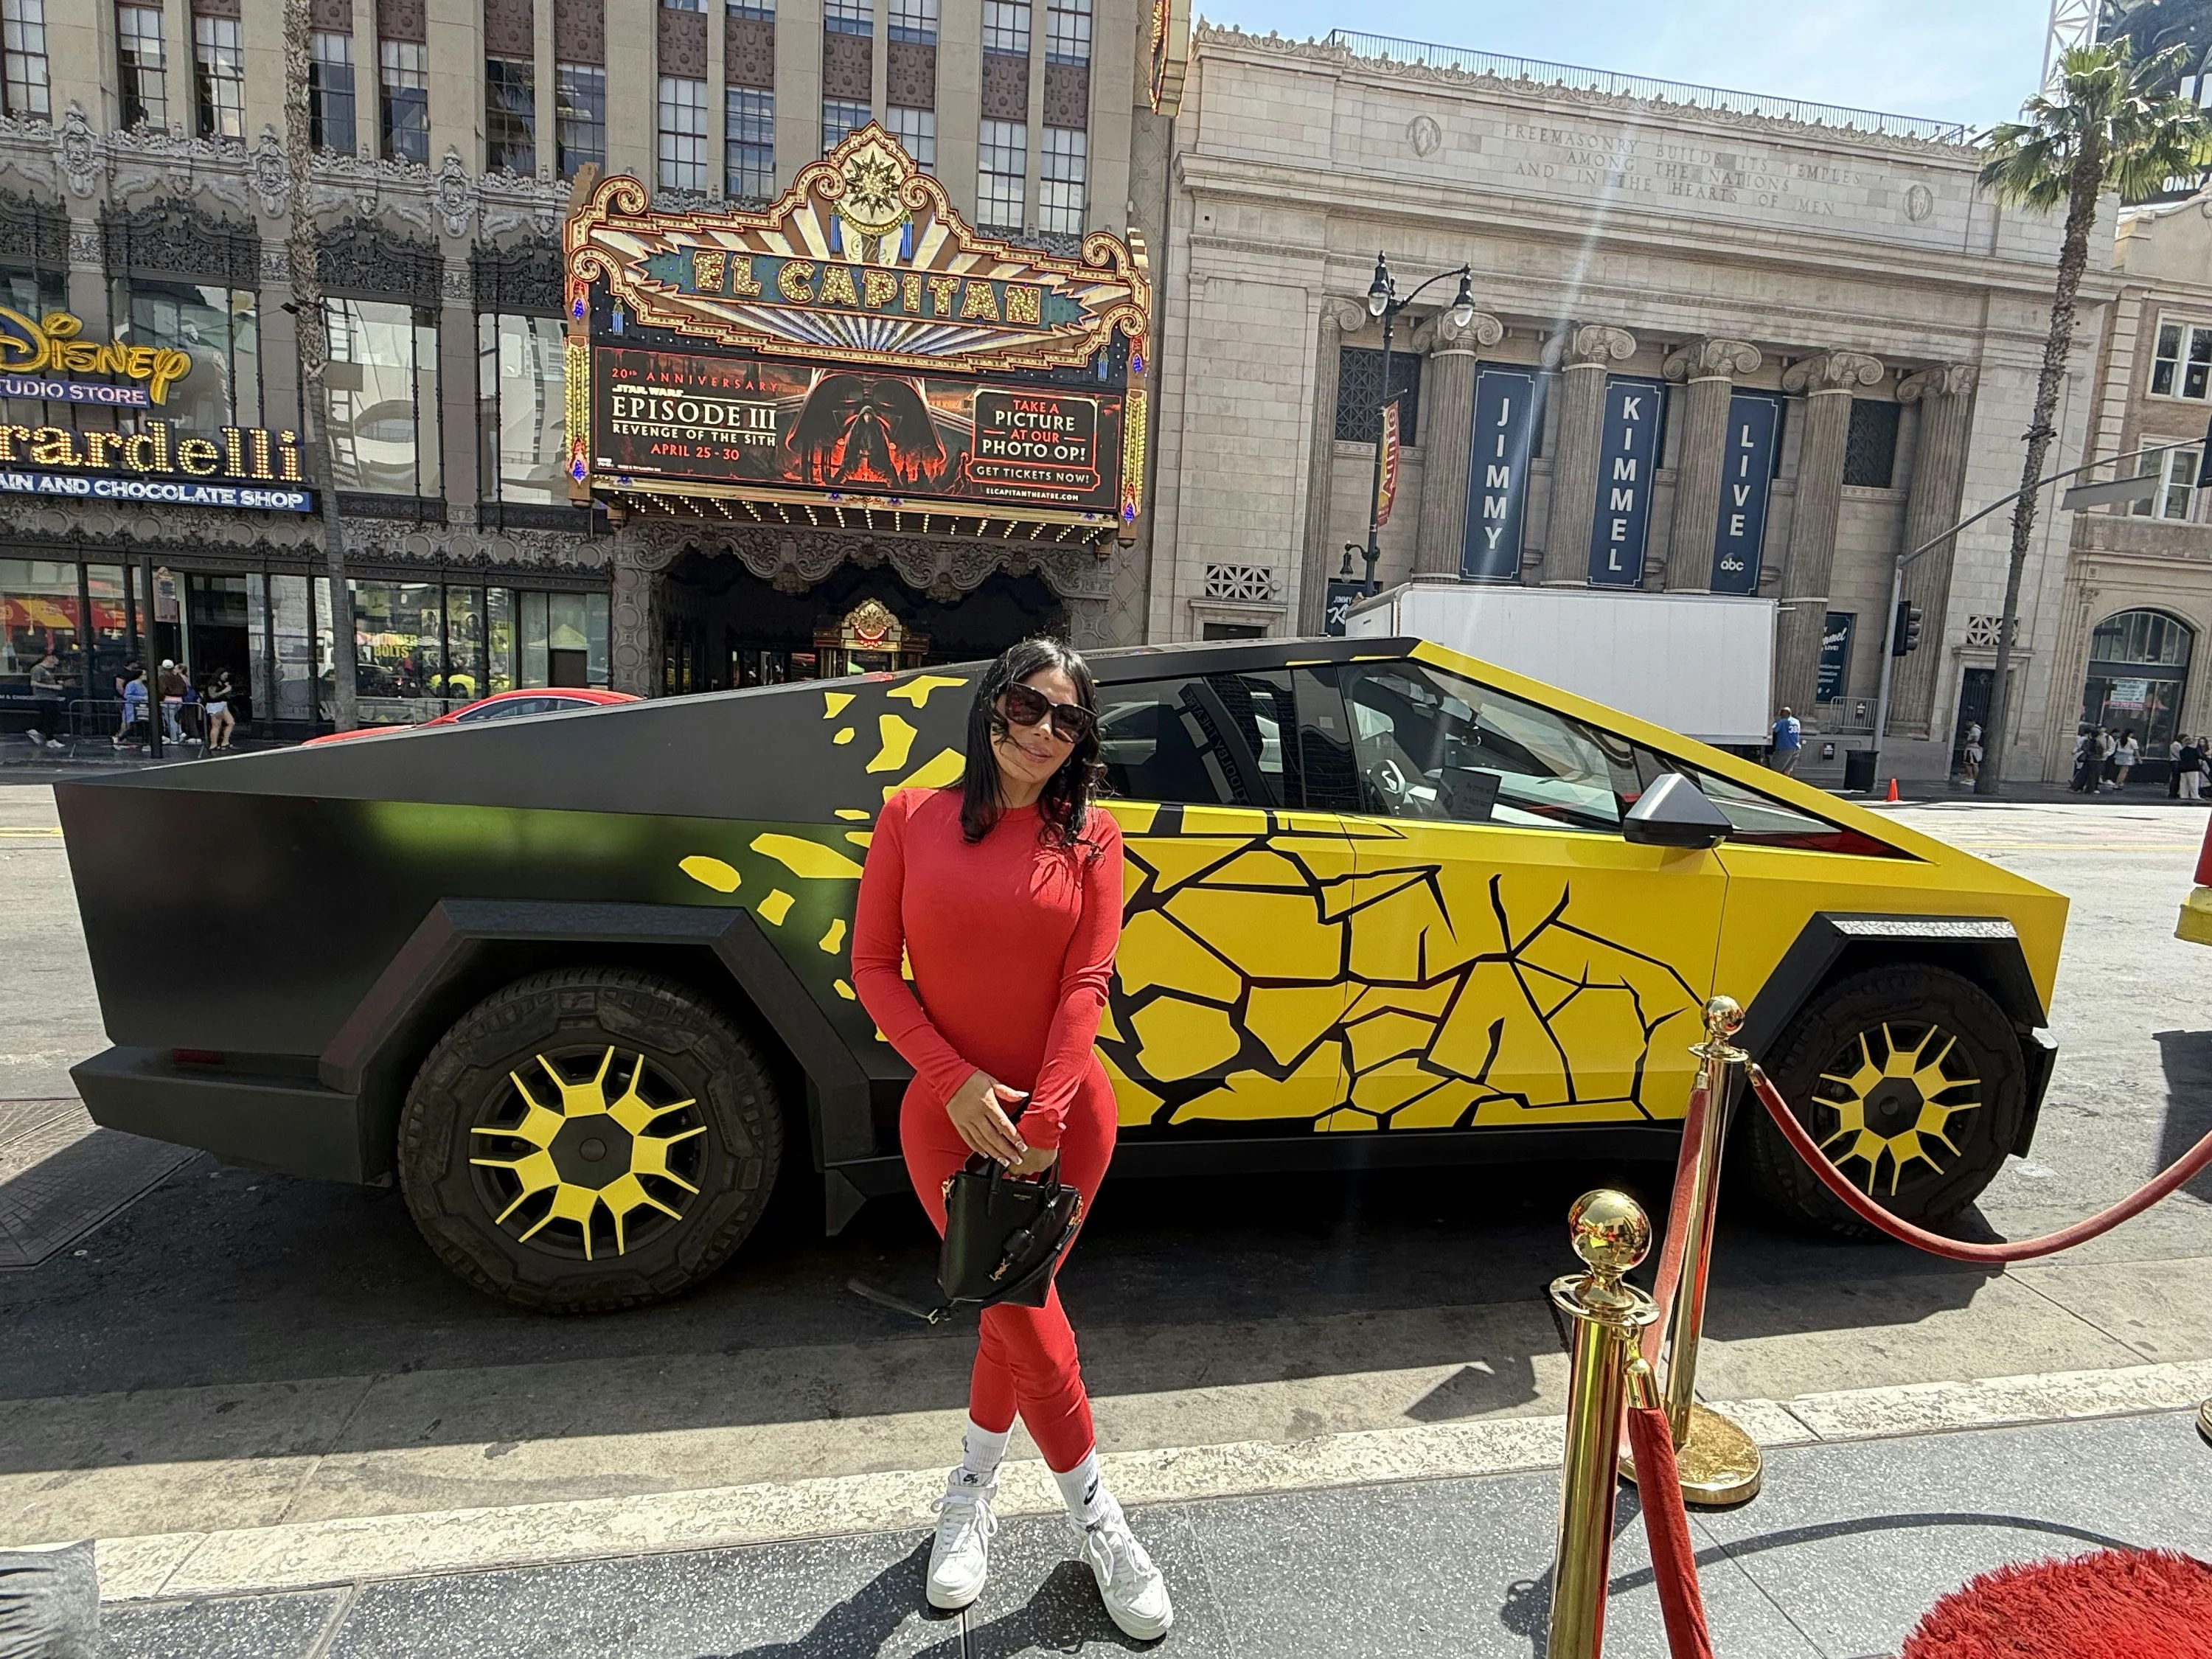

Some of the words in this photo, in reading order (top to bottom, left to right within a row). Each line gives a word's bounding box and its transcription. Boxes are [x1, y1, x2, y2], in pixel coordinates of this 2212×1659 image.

[1504, 124, 1638, 155] FREEMASONRY
[1657, 145, 1722, 164] BUILDS
[1736, 156, 1767, 172] ITS
[1785, 162, 1862, 185] TEMPLES
[1566, 150, 1635, 173] AMONG
[1655, 161, 1688, 179] THE
[1708, 170, 1790, 192] NATIONS
[2162, 173, 2205, 193] ONLY
[1515, 161, 1554, 178] AND
[1577, 170, 1597, 184] IN
[1617, 174, 1652, 192] THE
[1669, 181, 1739, 203] HEARTS
[1759, 194, 1778, 207] OF
[1799, 198, 1835, 216] MEN
[693, 251, 762, 296] EL
[777, 260, 1042, 325] CAPITAN
[611, 367, 638, 380] 20th
[646, 372, 778, 392] ANNIVERSARY
[611, 384, 648, 394] STAR
[648, 387, 684, 398] WARS
[69, 386, 147, 406] STORE
[1013, 399, 1047, 413] TAKE
[1049, 403, 1060, 414] A
[611, 395, 741, 428] EPISODE
[749, 407, 778, 431] III
[995, 410, 1076, 431] PICTURE
[613, 422, 679, 439] REVENGE
[686, 429, 705, 442] OF
[711, 431, 737, 444] THE
[745, 434, 776, 448] SITH
[1010, 429, 1029, 440] AT
[1031, 431, 1060, 444] OUR
[0, 420, 303, 482] rardelli
[650, 443, 690, 457] APRIL
[695, 447, 712, 459] 25
[723, 448, 741, 461] 30
[982, 439, 1048, 459] PHOTO
[1054, 445, 1087, 462] OP!
[976, 466, 1000, 477] GET
[1003, 467, 1051, 481] TICKETS
[1056, 472, 1090, 484] NOW!
[1484, 397, 1510, 550] JIMMY
[1608, 396, 1642, 572] KIMMEL
[1729, 424, 1755, 538] LIVE
[38, 476, 91, 495] AND
[94, 480, 238, 504] CHOCOLATE
[240, 490, 304, 509] SHOP
[986, 487, 1079, 502] ELCAPITANTHEATRE.COM
[1720, 557, 1745, 572] abc
[1333, 595, 1353, 605] JIMMY
